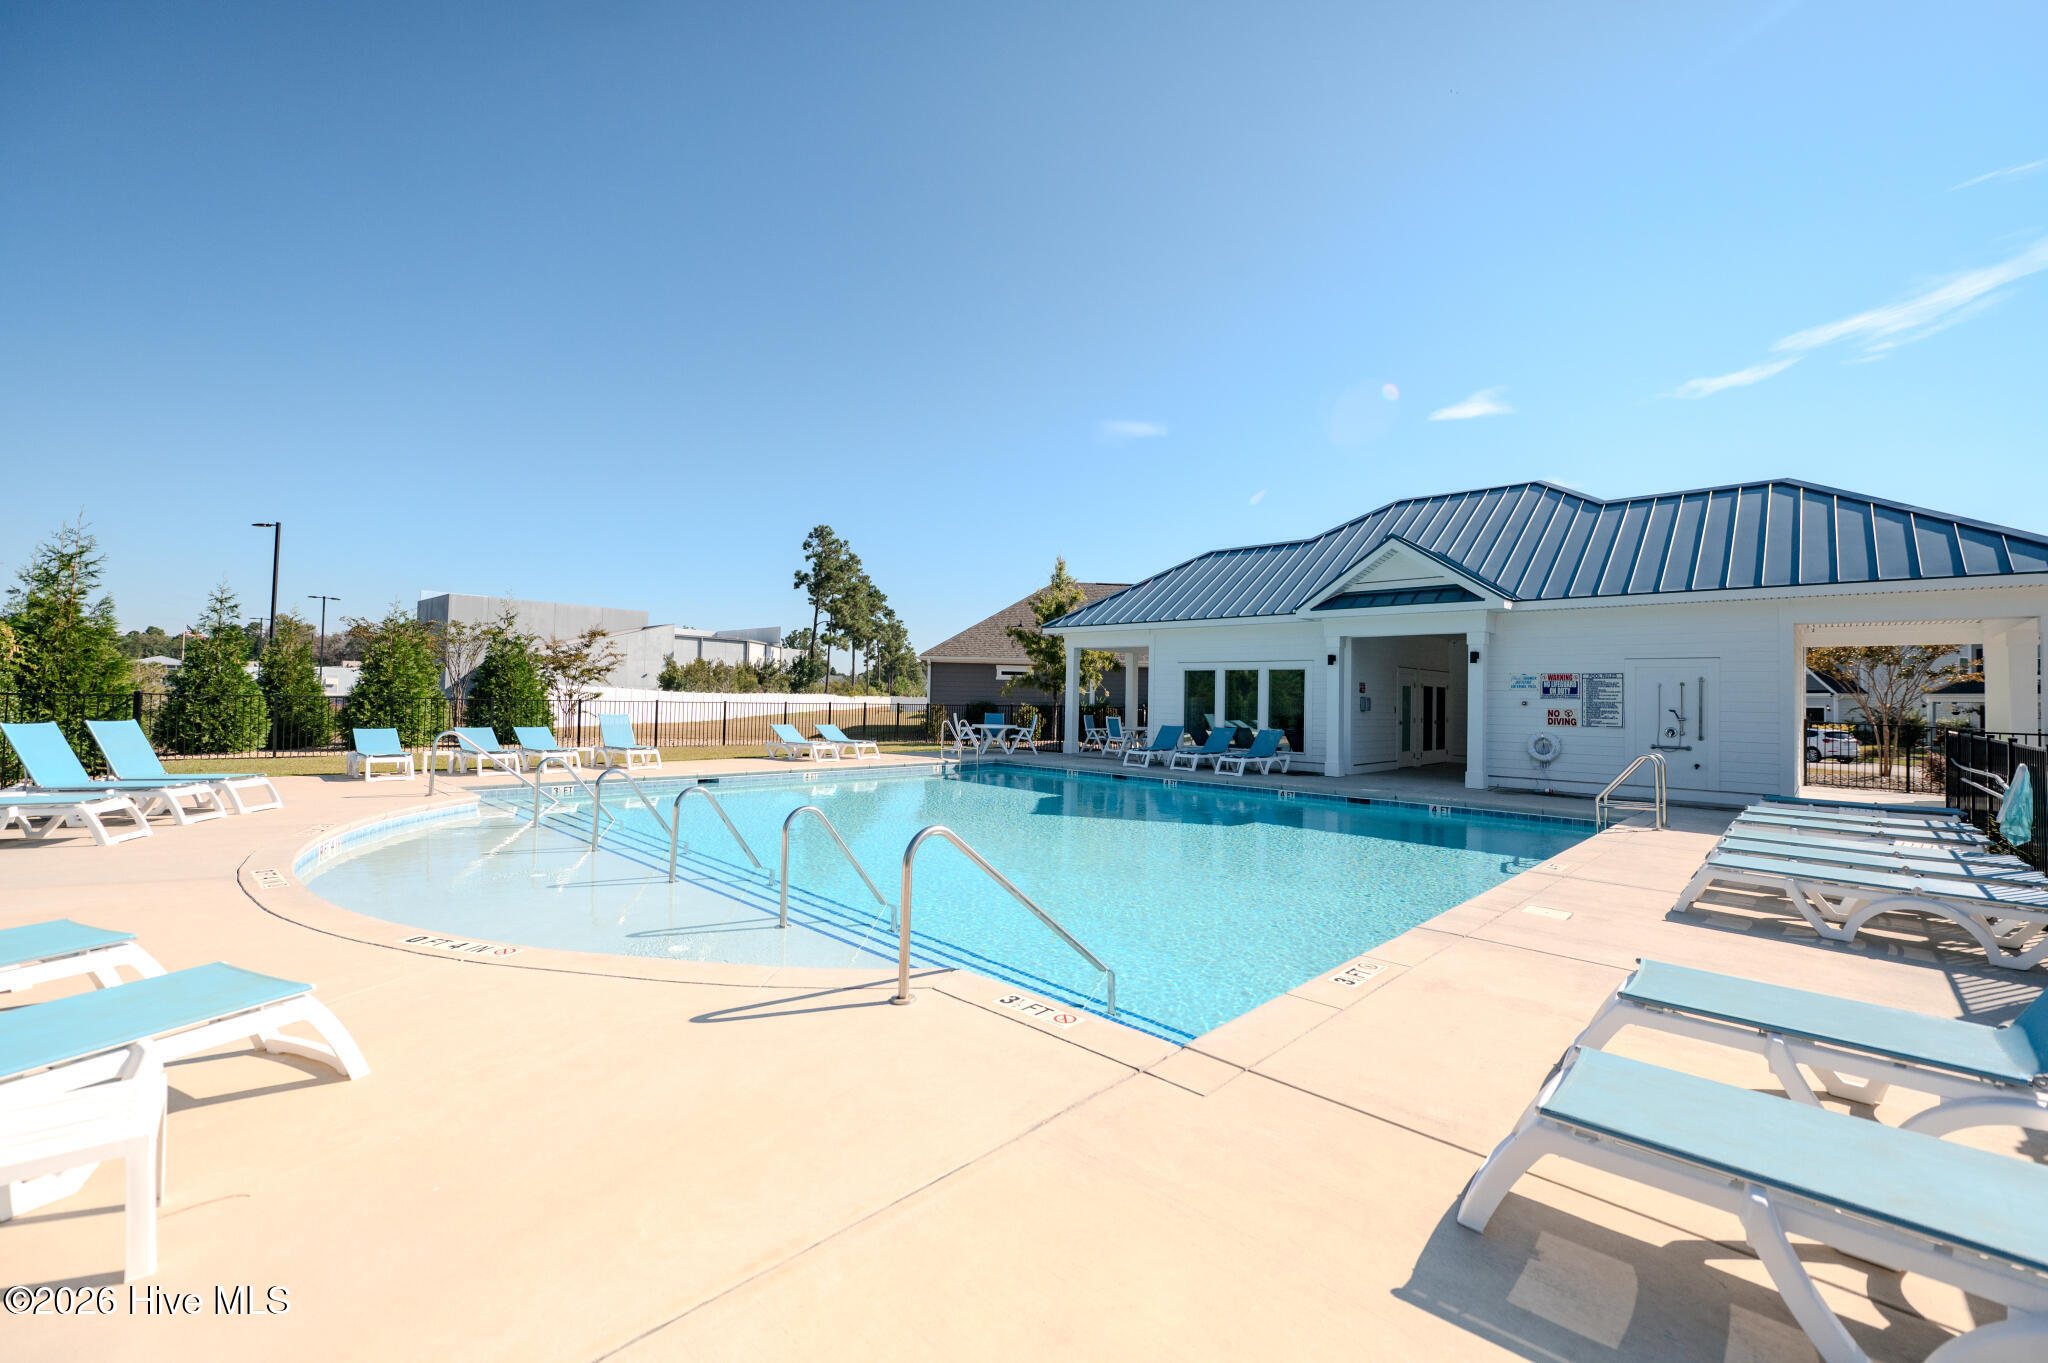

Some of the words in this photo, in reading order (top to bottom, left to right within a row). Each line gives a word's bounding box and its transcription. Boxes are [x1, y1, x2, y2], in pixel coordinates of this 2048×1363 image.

[1548, 673, 1573, 681] WARNING
[1548, 710, 1560, 718] NO
[1548, 718, 1577, 726] DIVING
[420, 938, 454, 947] FT
[448, 942, 470, 950] 4
[463, 944, 495, 953] IN
[1020, 1003, 1055, 1016] FT
